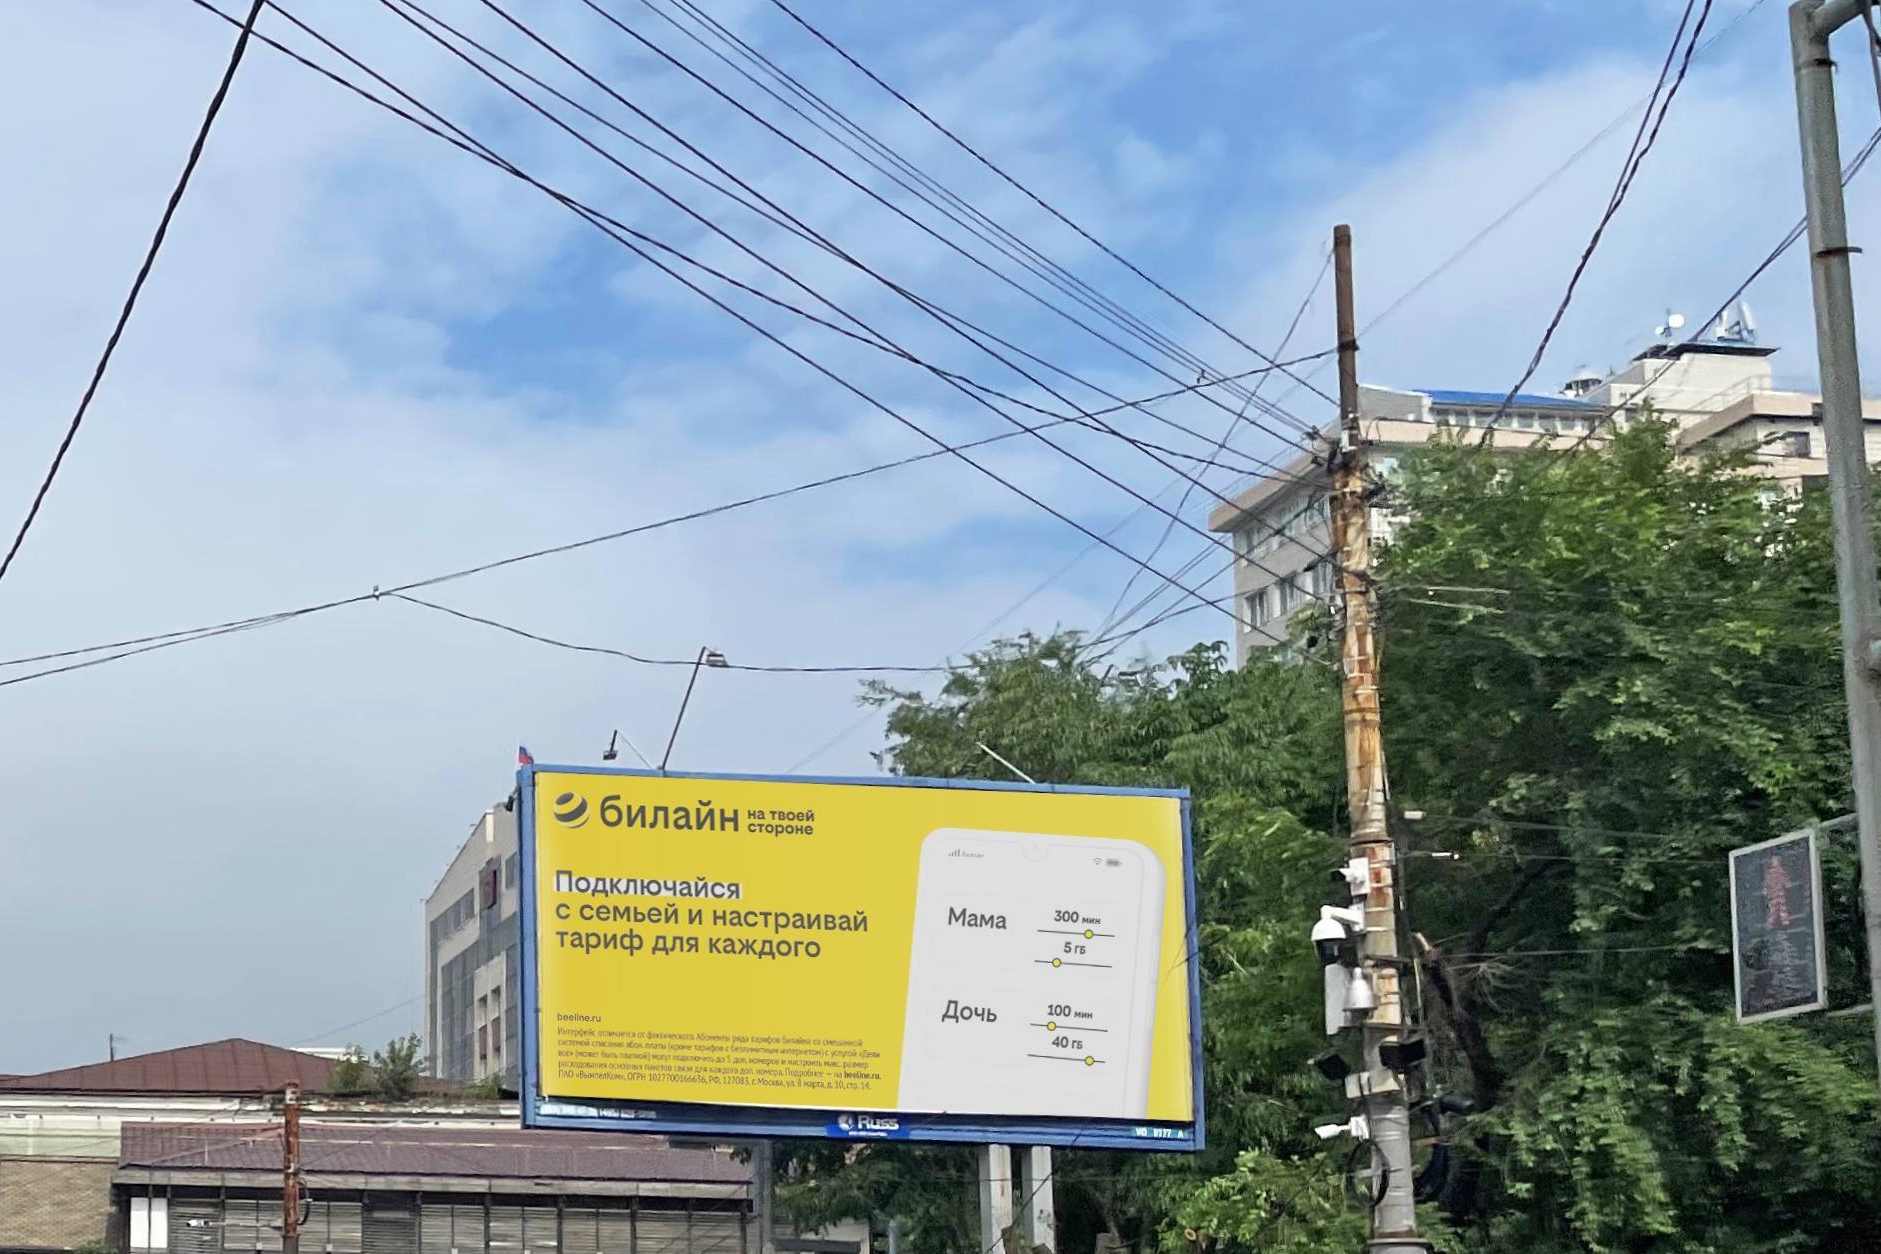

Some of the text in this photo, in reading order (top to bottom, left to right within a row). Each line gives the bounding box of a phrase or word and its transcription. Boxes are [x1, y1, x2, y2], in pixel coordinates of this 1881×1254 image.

[599, 794, 740, 832] билайн
[747, 808, 815, 822] на твоей
[747, 822, 814, 837] стороне
[555, 869, 741, 899] Подключайся
[555, 902, 868, 934] с семьей и настраивай
[948, 907, 1007, 930] Мама
[1054, 910, 1101, 925] 300 мин
[556, 928, 822, 960] тариф для каждого
[1063, 942, 1072, 954] 5
[557, 1013, 602, 1023] beeline.ru
[941, 1000, 998, 1023] Дочь
[1047, 1004, 1093, 1019] 100 мин
[1052, 1036, 1069, 1048] 40
[558, 1069, 574, 1078] ПАО
[627, 1071, 646, 1080] ОГРН
[858, 1115, 900, 1130] Russ
